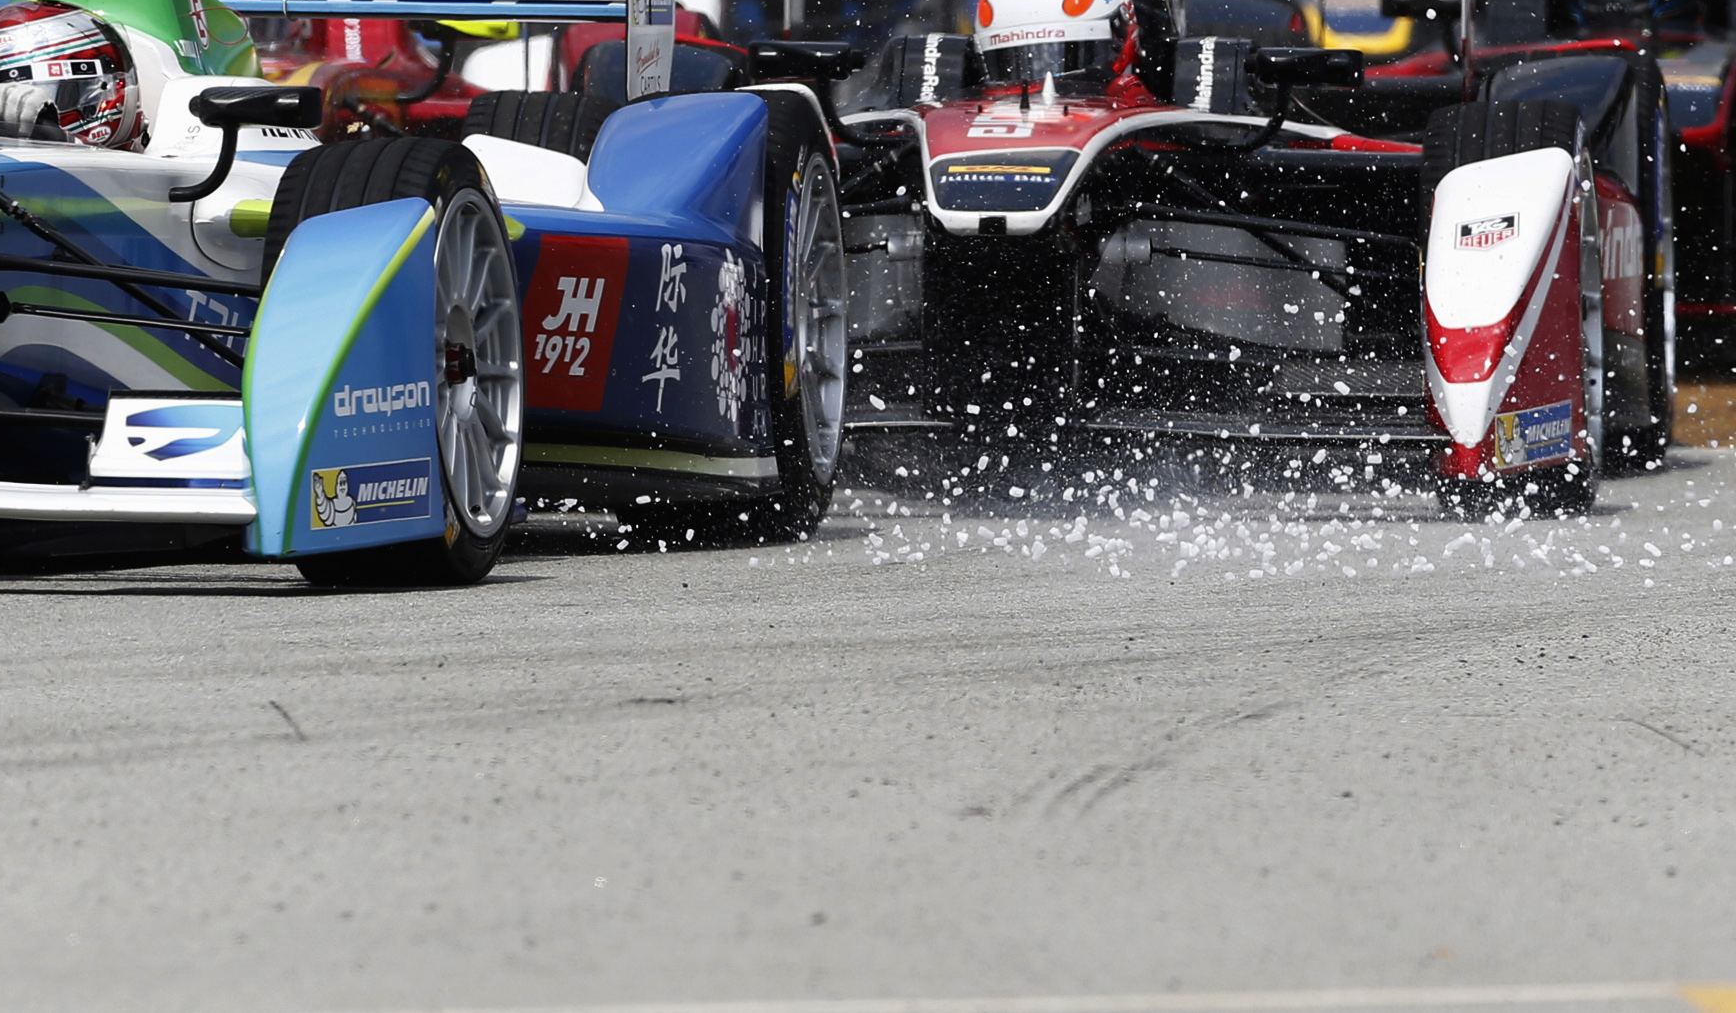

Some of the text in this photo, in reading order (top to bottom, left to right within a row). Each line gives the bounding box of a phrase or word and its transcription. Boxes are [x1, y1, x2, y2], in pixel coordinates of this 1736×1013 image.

[990, 29, 1065, 46] Mahindra
[91, 129, 110, 140] BELL
[1459, 229, 1514, 249] HEUER
[541, 276, 605, 333] JH
[642, 243, 687, 413] 际华
[534, 333, 591, 376] 1912
[334, 381, 431, 417] drayson
[1527, 418, 1570, 442] MICHELIN
[356, 477, 429, 503] MICHELIN
